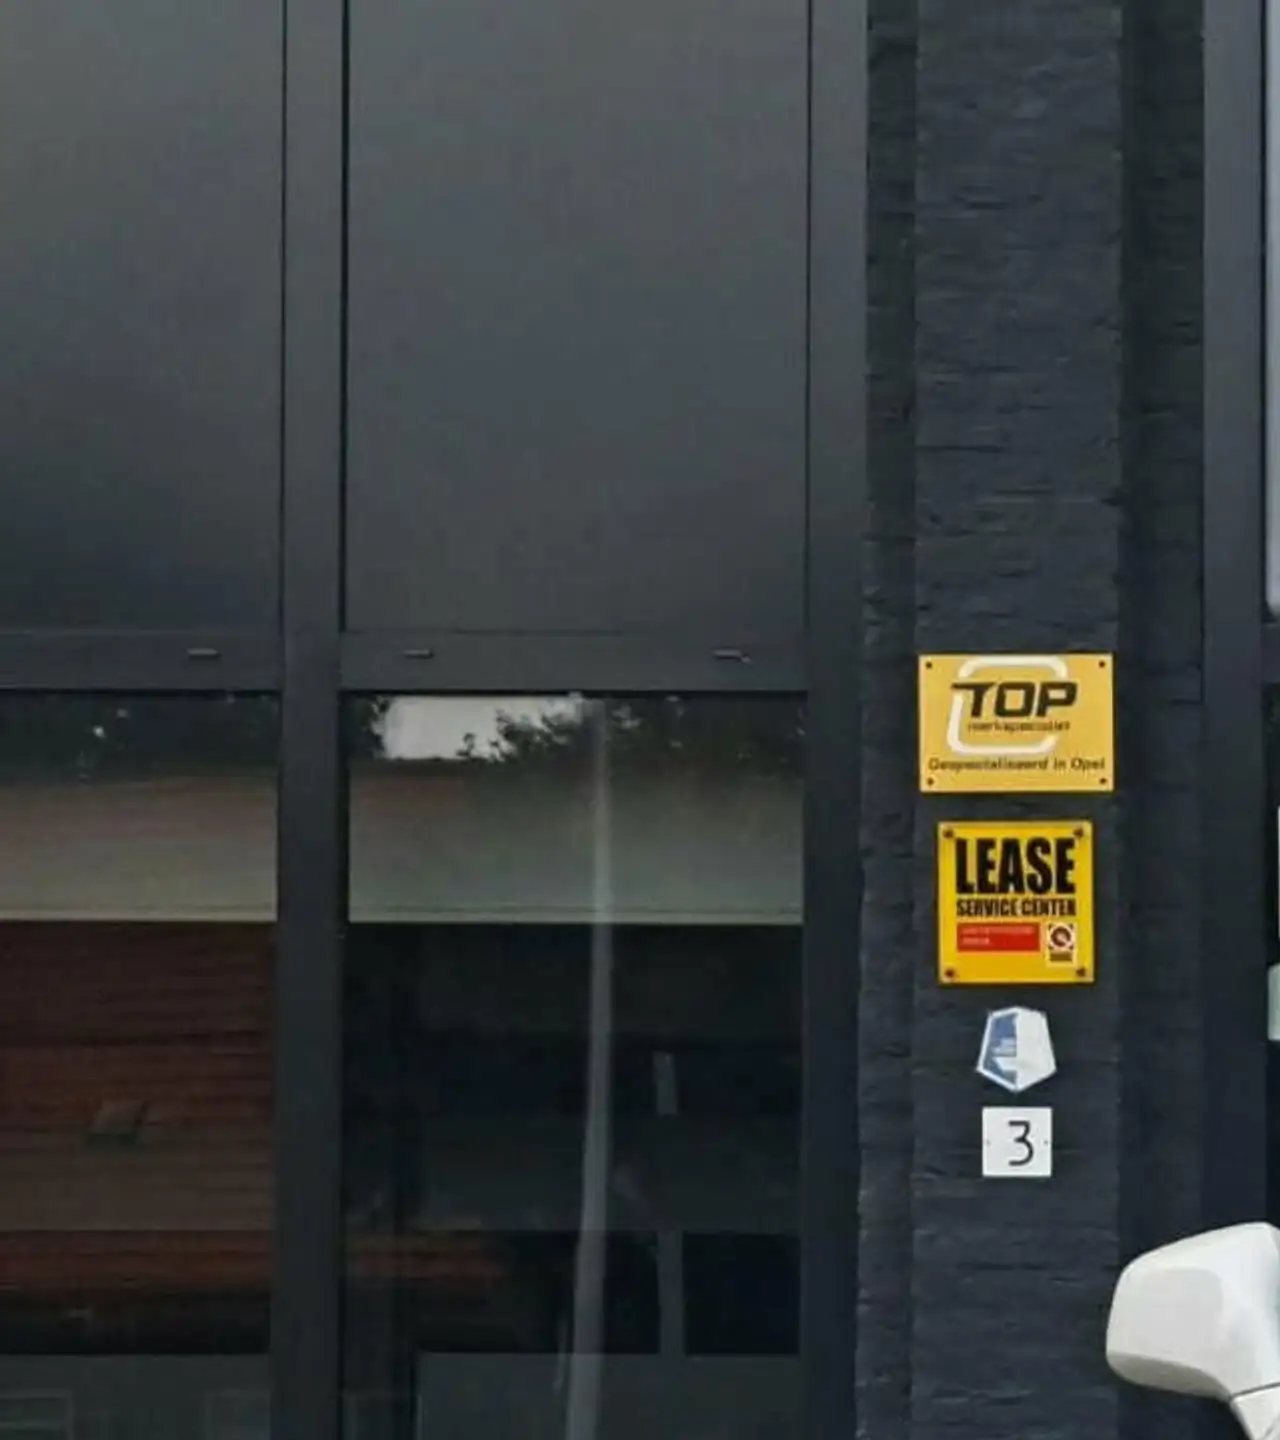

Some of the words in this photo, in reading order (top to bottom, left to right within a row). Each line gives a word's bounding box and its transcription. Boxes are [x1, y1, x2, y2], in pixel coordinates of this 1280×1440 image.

[950, 680, 1079, 718] TOP
[1070, 757, 1106, 775] Opel
[955, 837, 1077, 895] LEASE
[956, 899, 1018, 917] SERVICE
[1021, 898, 1077, 917] CENTER
[1008, 1120, 1034, 1167] 3
